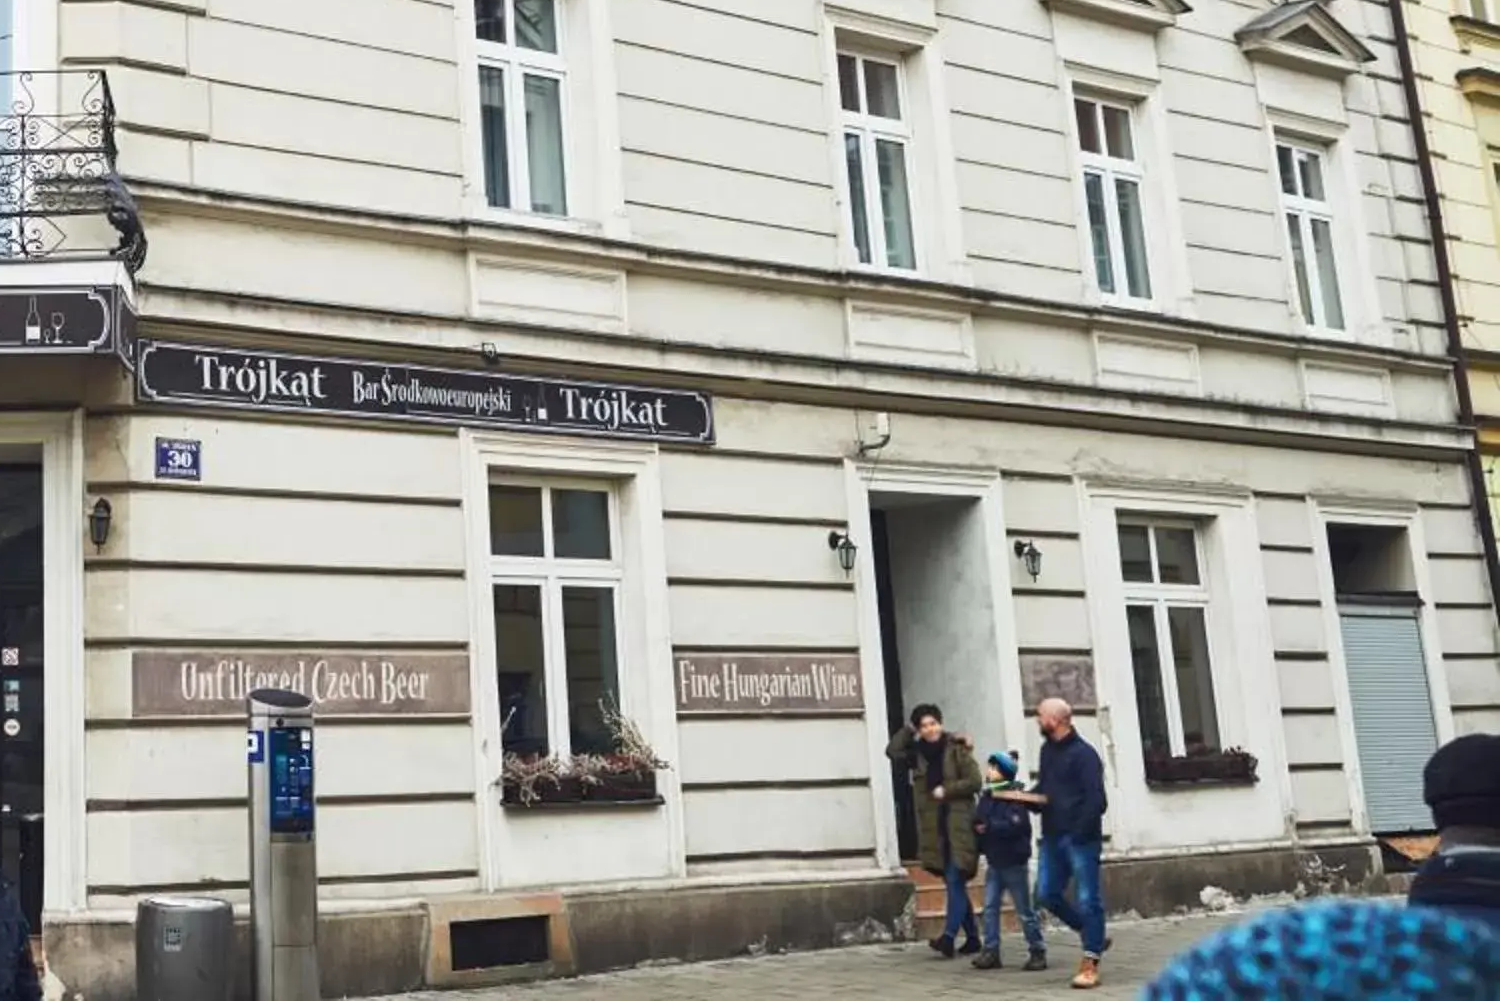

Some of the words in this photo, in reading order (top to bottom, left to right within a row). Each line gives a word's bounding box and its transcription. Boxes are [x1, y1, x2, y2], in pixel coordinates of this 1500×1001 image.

[194, 354, 328, 406] Trójkąt
[352, 370, 379, 404] Bar
[381, 366, 512, 415] Środkowoeuropejski
[559, 387, 669, 433] Trójkąt
[167, 450, 192, 467] 30
[312, 659, 375, 703] Czech
[381, 661, 429, 704] Beer
[679, 660, 720, 704] Fine
[722, 663, 811, 706] Hungarian
[811, 663, 857, 701] Wine
